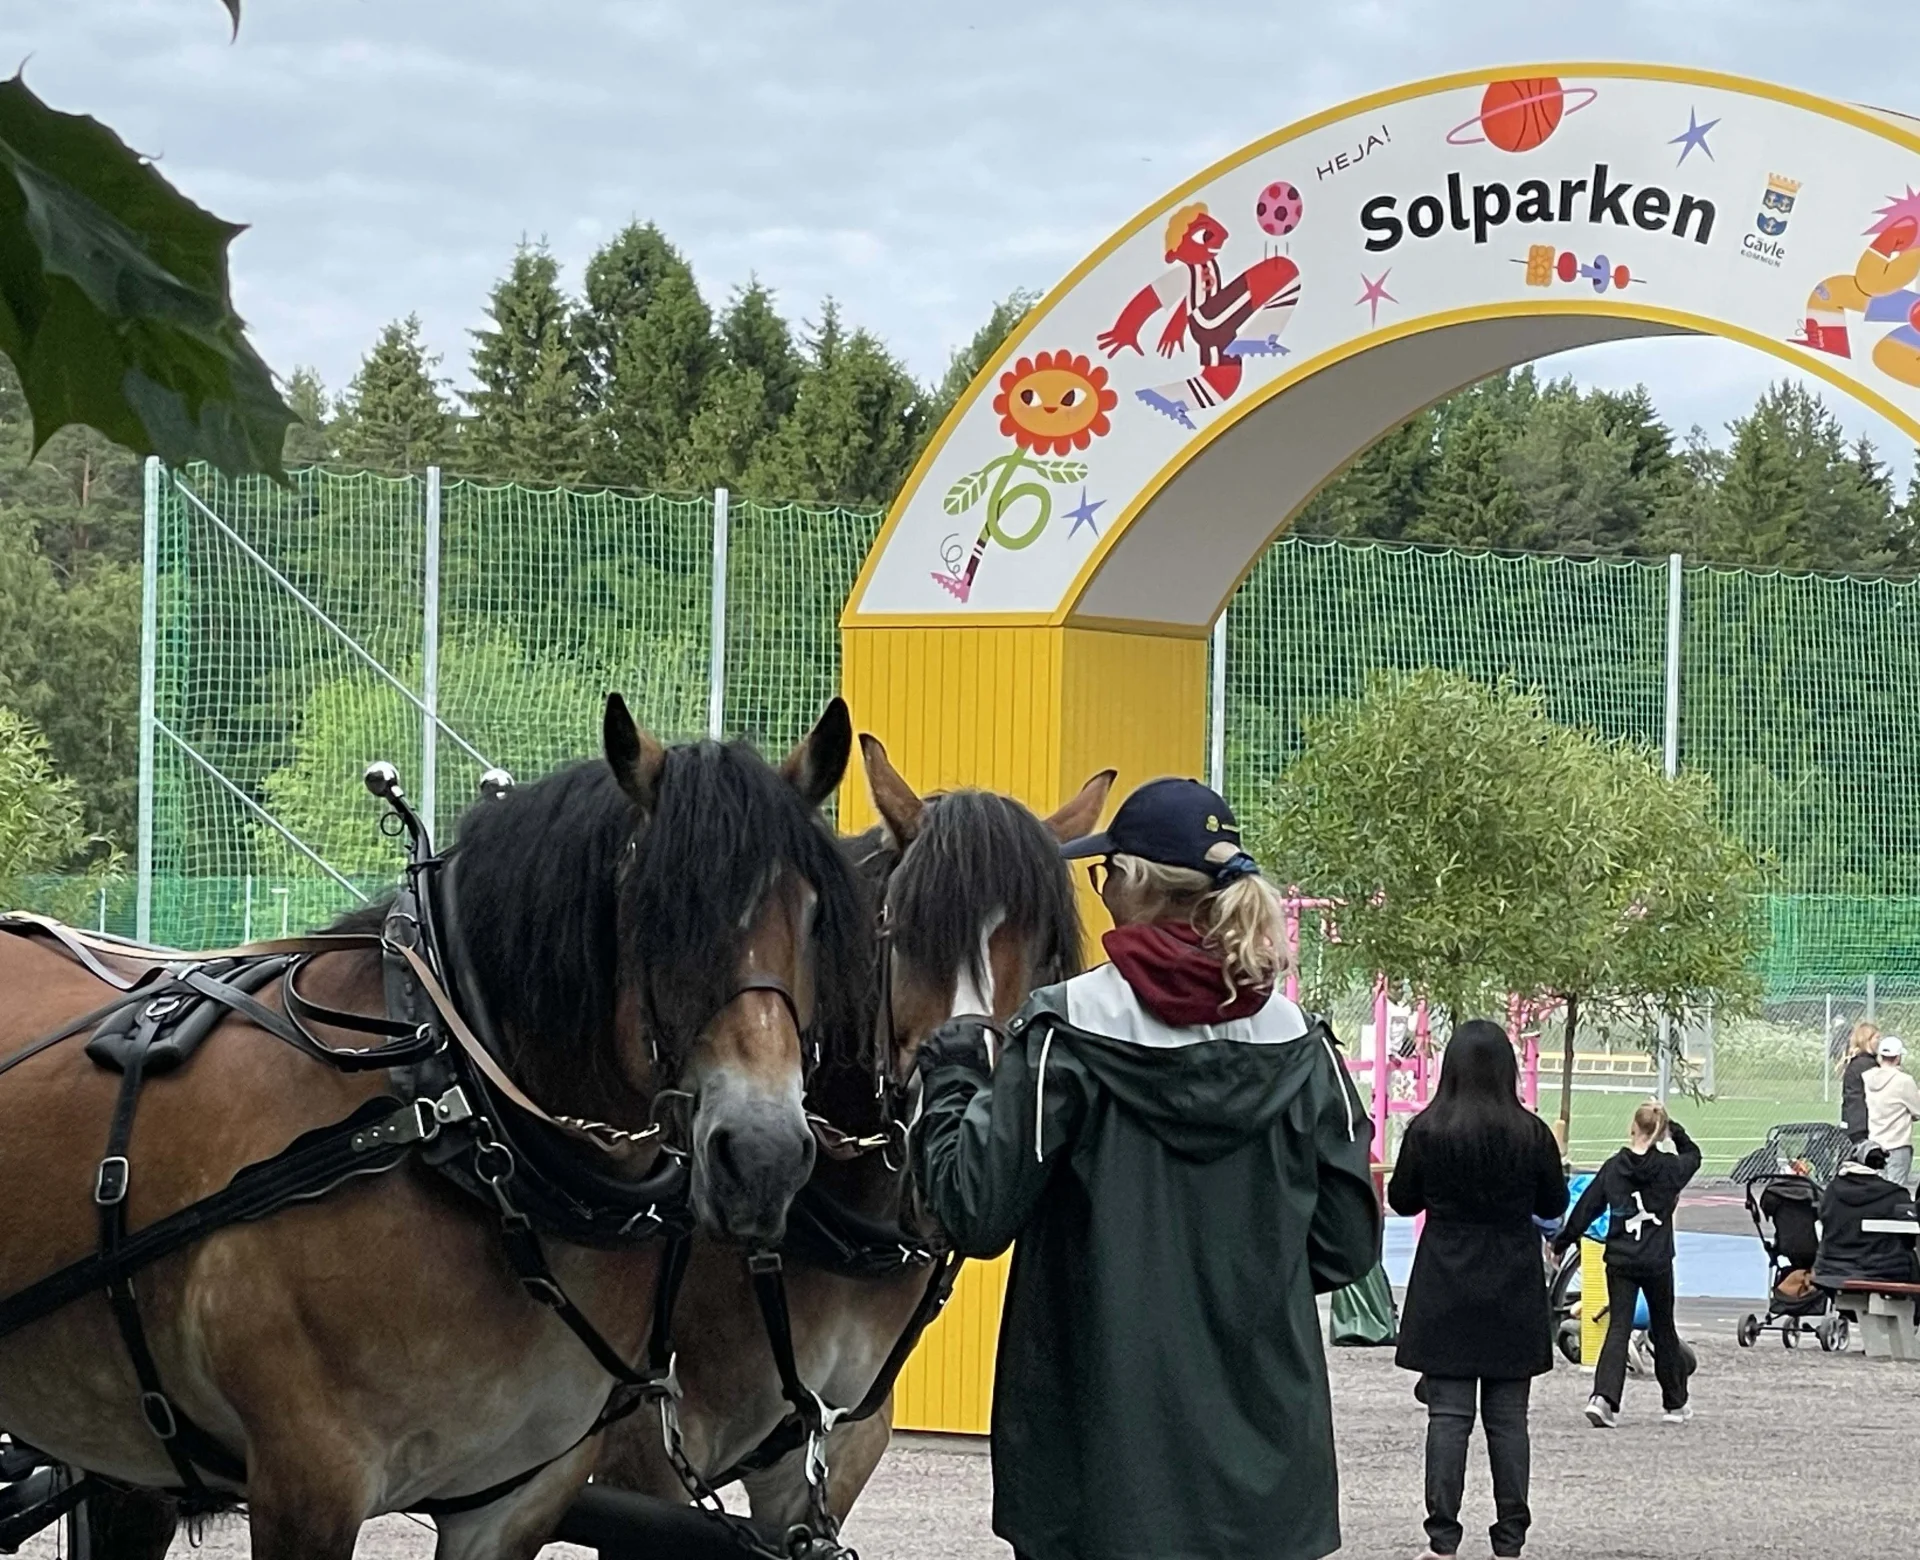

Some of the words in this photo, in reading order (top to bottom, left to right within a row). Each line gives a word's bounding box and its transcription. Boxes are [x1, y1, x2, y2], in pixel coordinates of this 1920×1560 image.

[1316, 124, 1391, 181] HEJA!
[1360, 163, 1717, 252] Solparken
[1740, 249, 1781, 267] KOMMUN
[1743, 233, 1785, 259] Gävle
